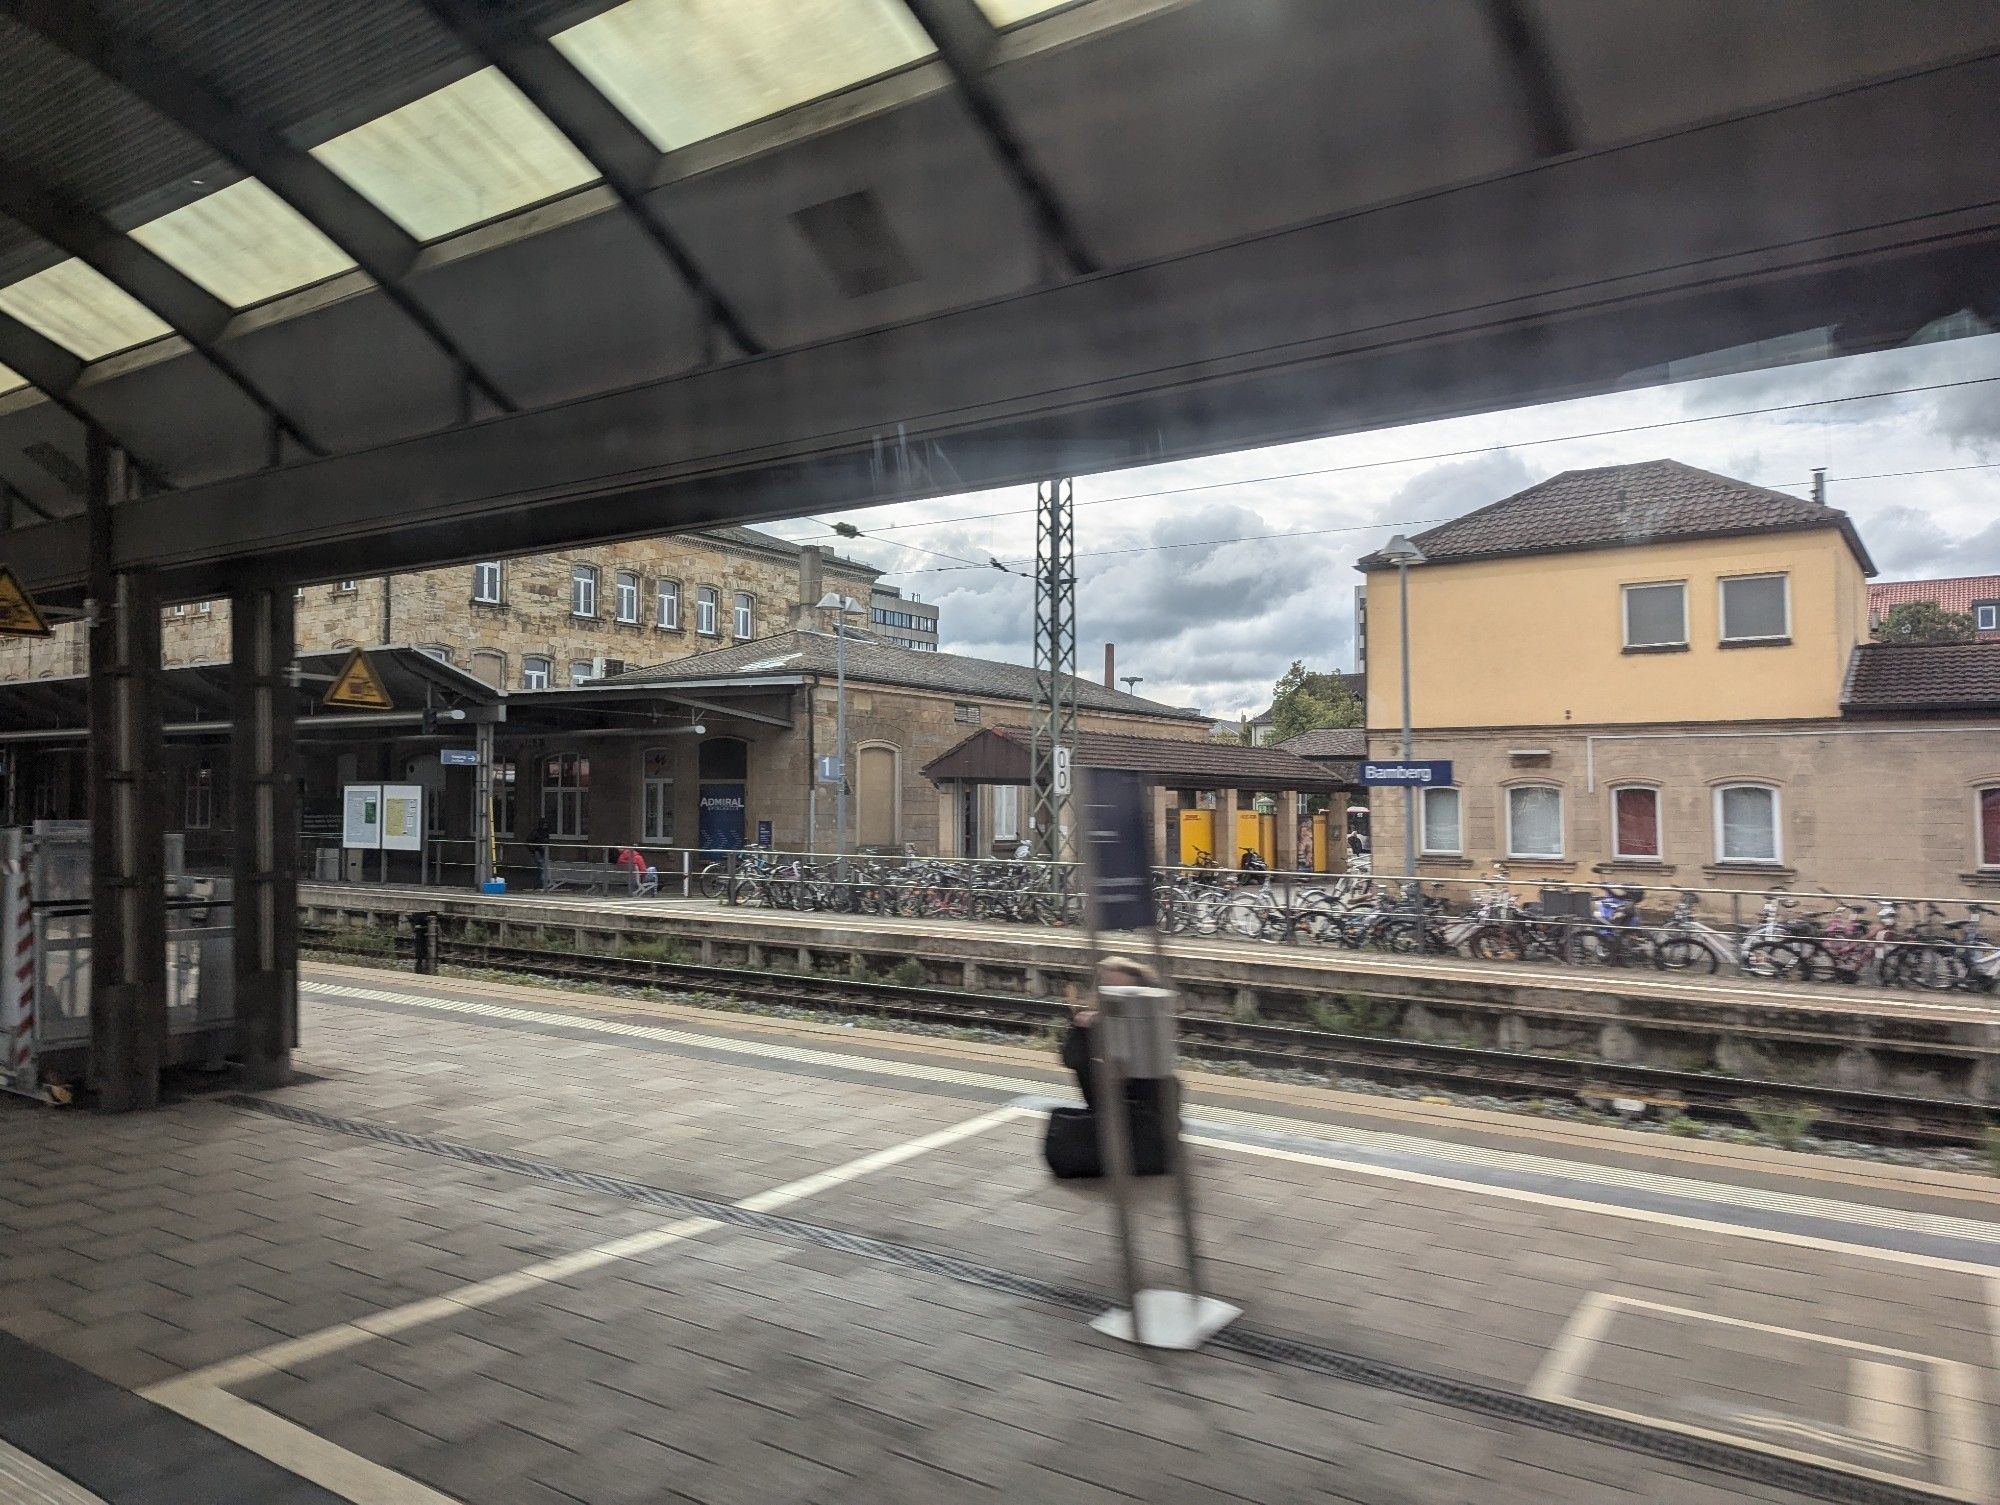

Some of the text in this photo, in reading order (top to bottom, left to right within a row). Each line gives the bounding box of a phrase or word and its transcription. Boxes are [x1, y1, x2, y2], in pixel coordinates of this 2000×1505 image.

[822, 757, 830, 776] 1
[1365, 765, 1432, 782] Bamberg
[700, 797, 745, 808] ADMIRAL
